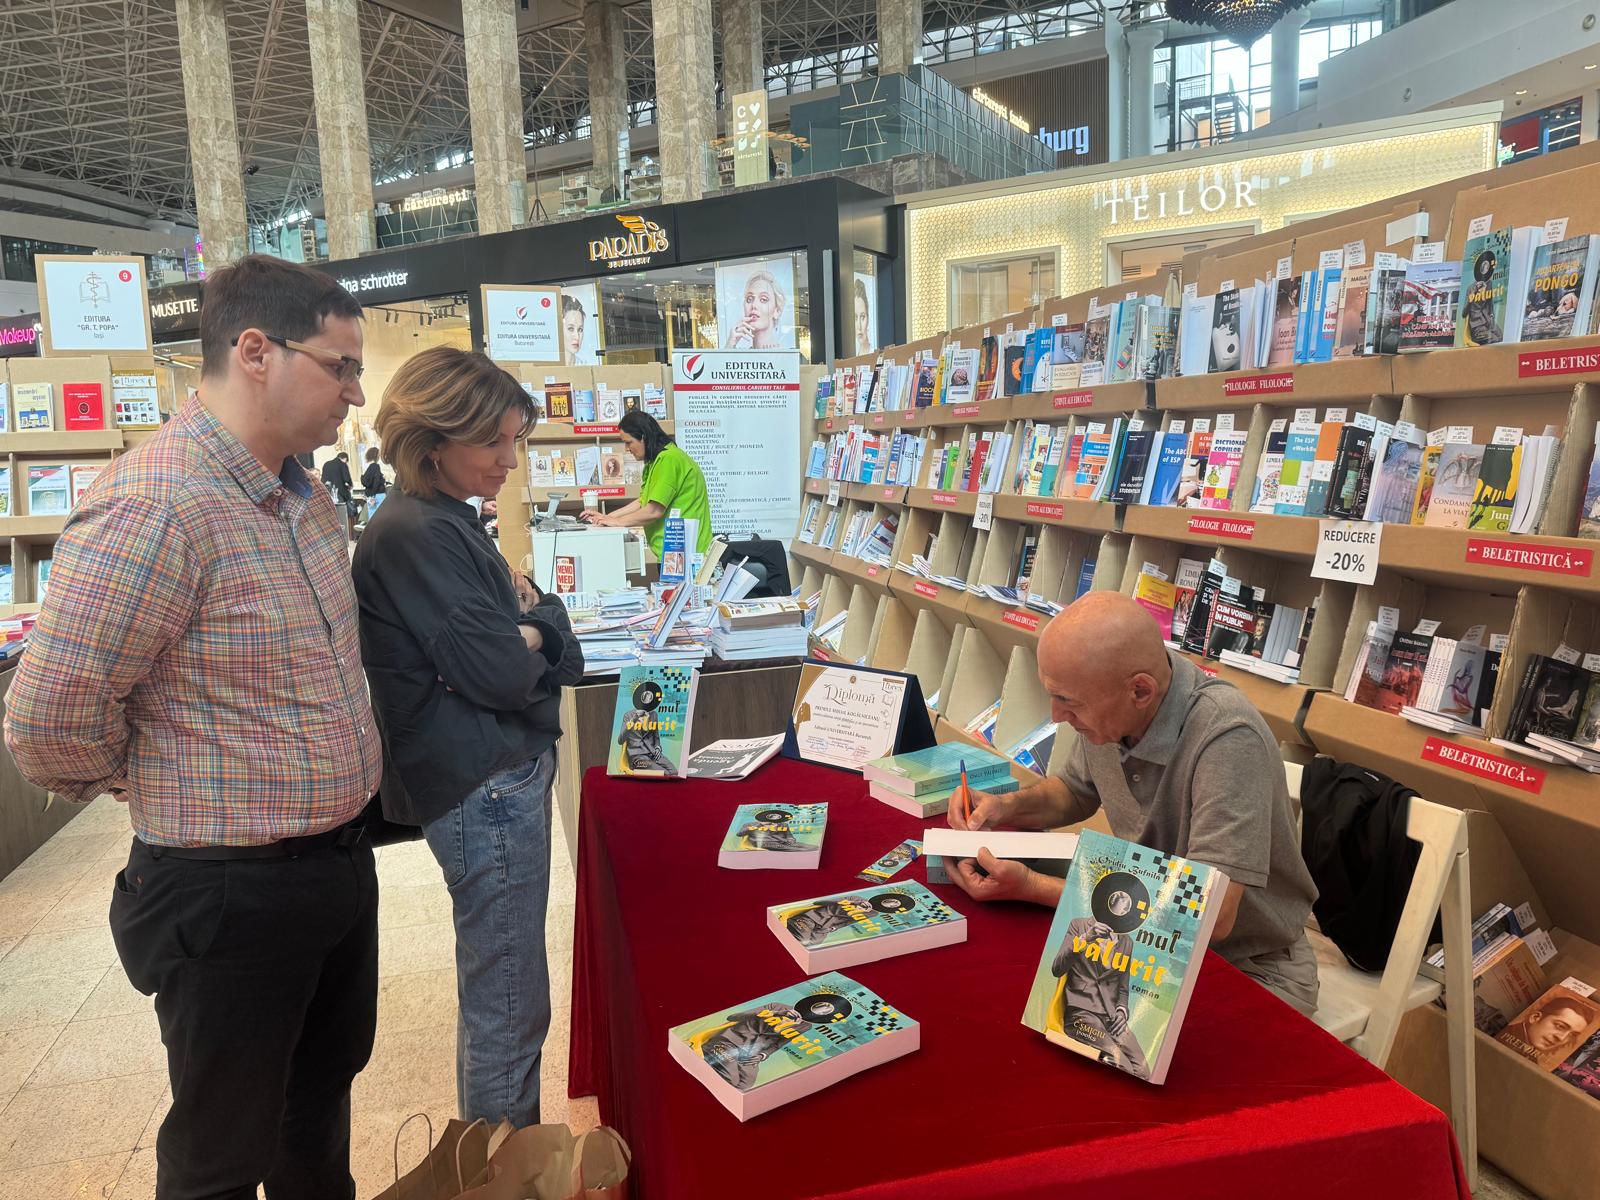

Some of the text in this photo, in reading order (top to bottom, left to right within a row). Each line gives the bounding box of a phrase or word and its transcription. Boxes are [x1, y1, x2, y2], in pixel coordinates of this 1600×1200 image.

[1104, 180, 1256, 225] TEILOR
[588, 228, 668, 261] PARADIS
[608, 256, 650, 268] JEWELLERY
[336, 271, 408, 294] ina schrotter
[1534, 272, 1578, 292] PONGO
[151, 298, 198, 318] MUSETTE
[0, 327, 36, 345] Makeup
[725, 362, 774, 370] EDITURA
[1536, 354, 1600, 371] BELETRIS
[711, 370, 786, 379] UNIVERSITARĂ
[1226, 380, 1256, 392] FILOLOGIE
[1434, 498, 1471, 507] CONDAMN
[1497, 522, 1508, 530] G
[1324, 530, 1376, 544] REDUCERE
[1326, 552, 1365, 572] -20%
[1482, 546, 1571, 569] BELETRISTICĂ
[558, 575, 573, 584] MED
[1216, 604, 1230, 614] CUM
[1222, 616, 1244, 627] PUBLIC
[824, 683, 875, 706] Diplomă
[1438, 745, 1525, 782] BELETRISTICĂ
[1131, 984, 1160, 999] roman
